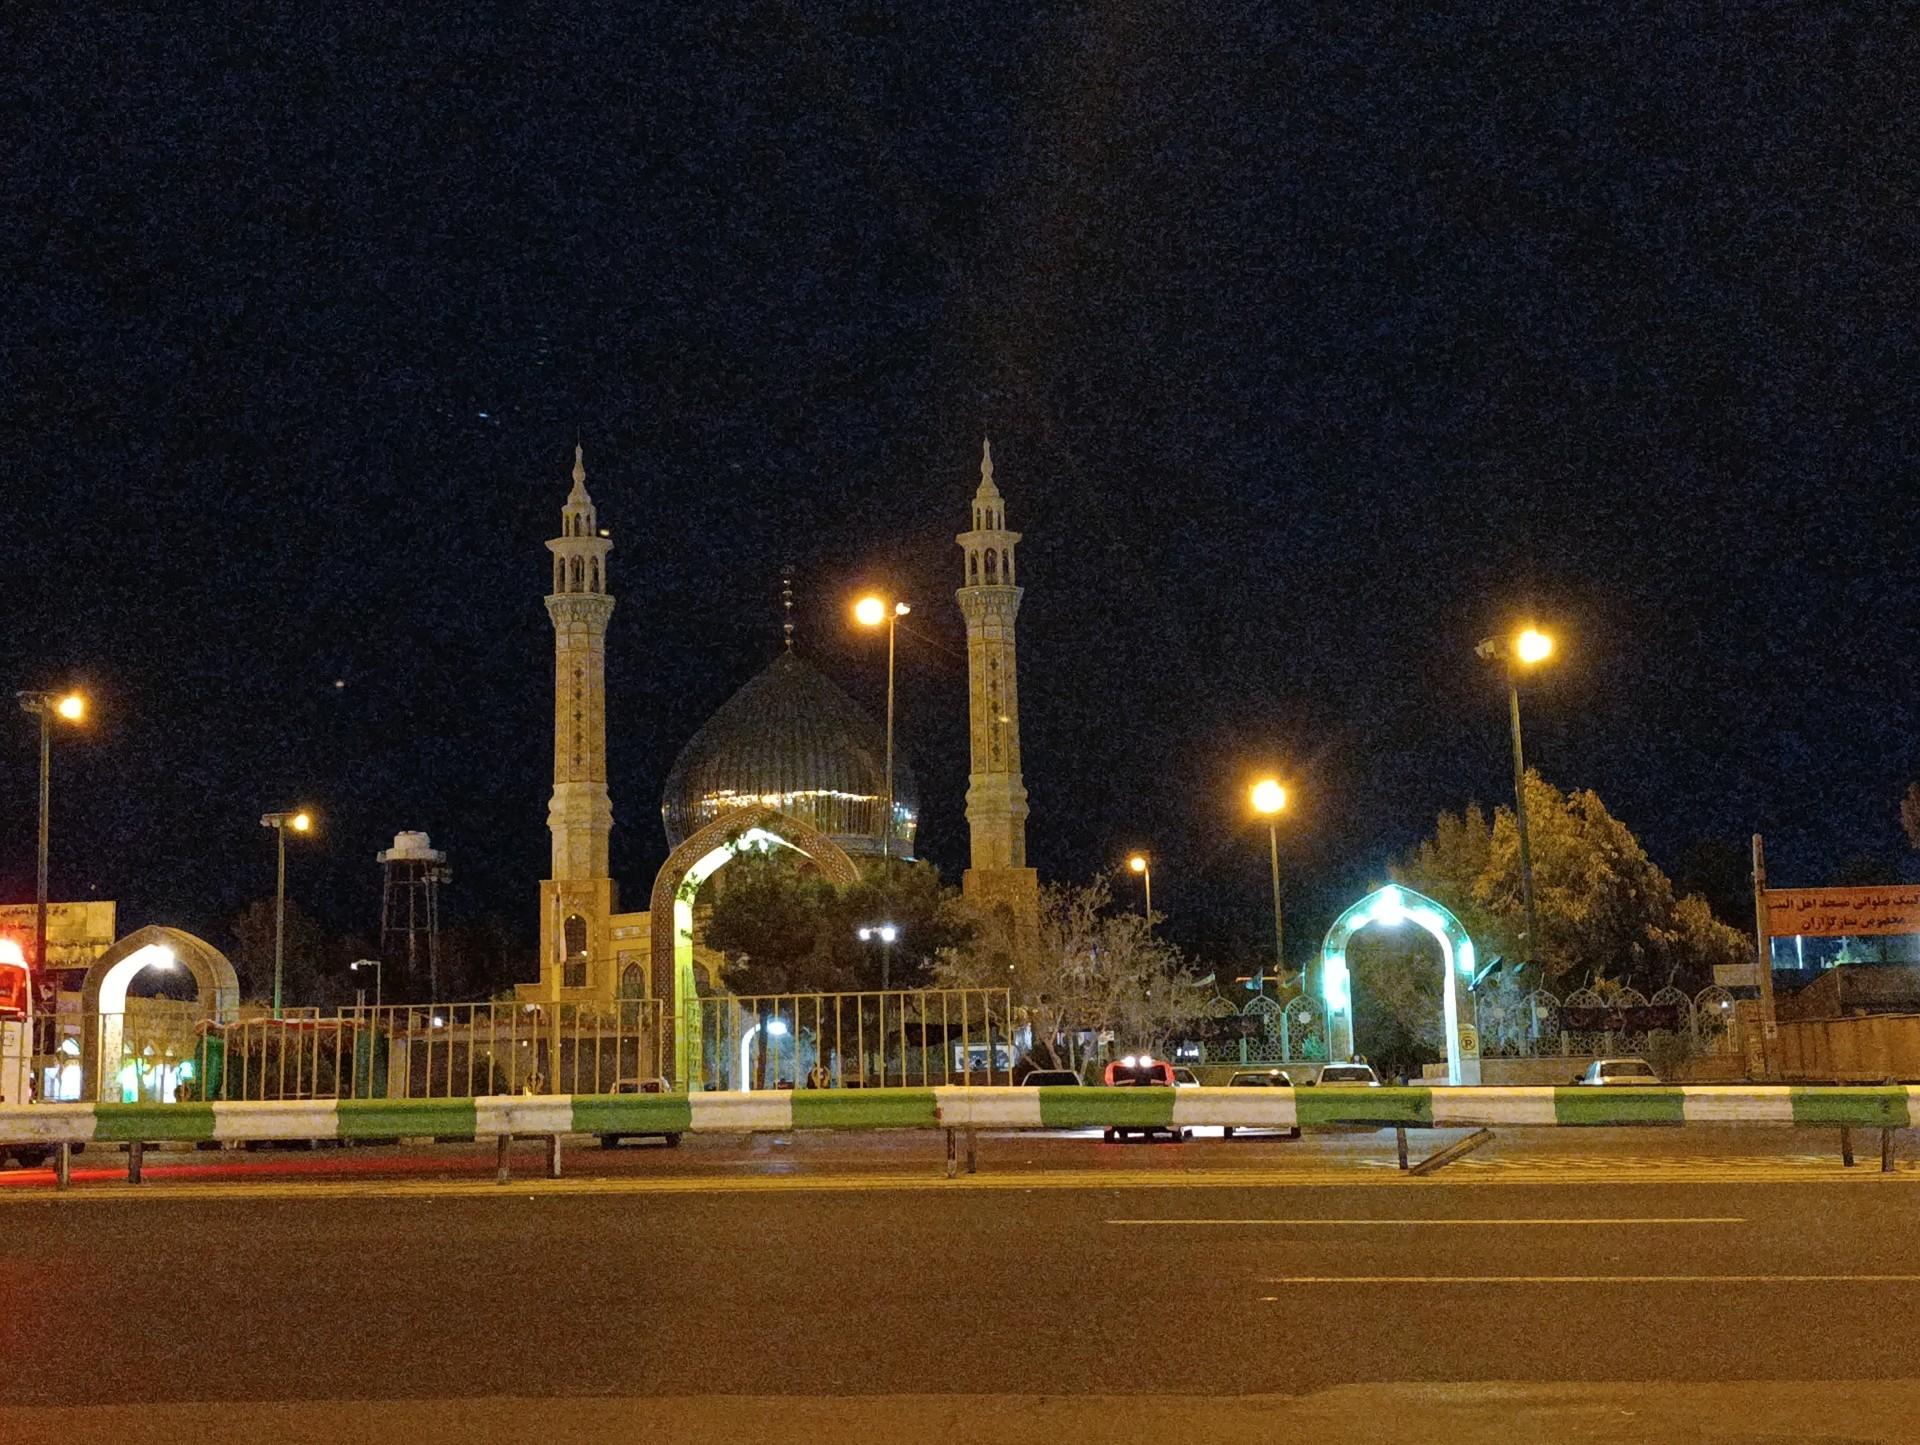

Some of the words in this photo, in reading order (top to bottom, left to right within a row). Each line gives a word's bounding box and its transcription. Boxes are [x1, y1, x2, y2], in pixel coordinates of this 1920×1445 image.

[1797, 898, 1817, 912] اهل
[1819, 898, 1850, 908] مسجد
[1861, 916, 1905, 929] مخصوص
